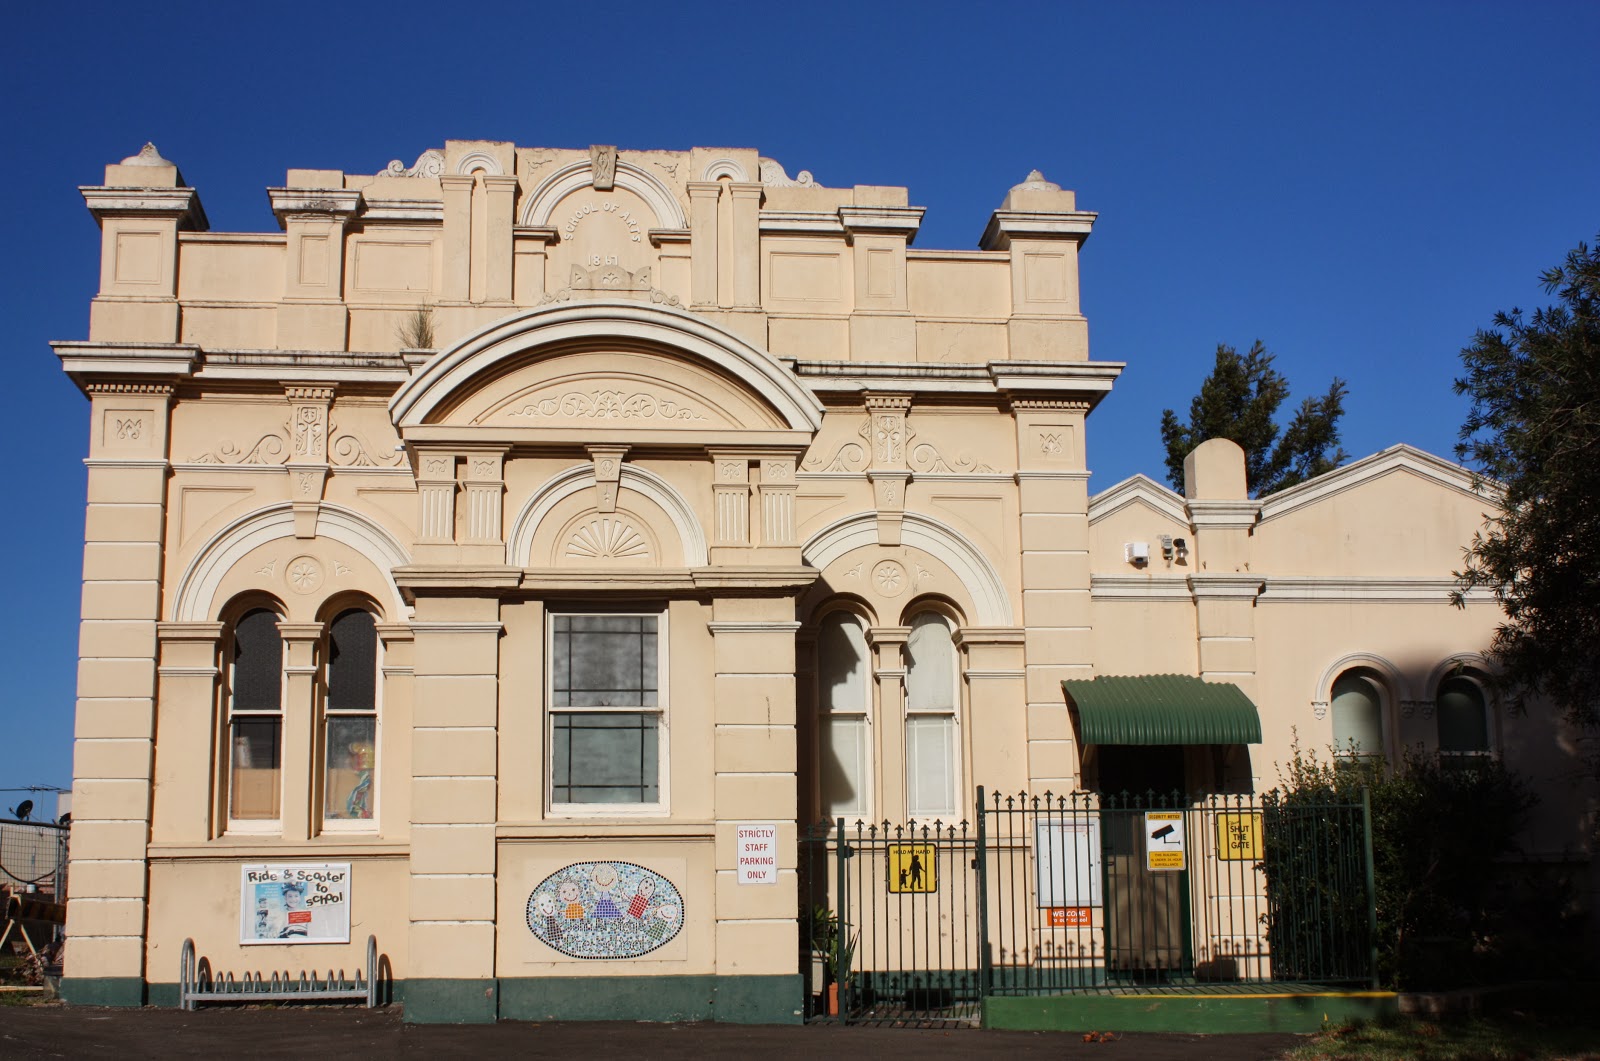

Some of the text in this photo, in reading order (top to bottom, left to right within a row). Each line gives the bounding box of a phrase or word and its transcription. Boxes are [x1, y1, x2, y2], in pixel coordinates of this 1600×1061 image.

[564, 201, 642, 243] SCHOOL OF ARTS
[739, 829, 774, 838] STRICTLY
[745, 843, 768, 852] STAFF
[1231, 841, 1249, 849] GATE
[740, 857, 774, 865] PARKING
[248, 869, 345, 882] Ride & Scooter
[747, 871, 767, 879] ONLY
[316, 882, 328, 893] to
